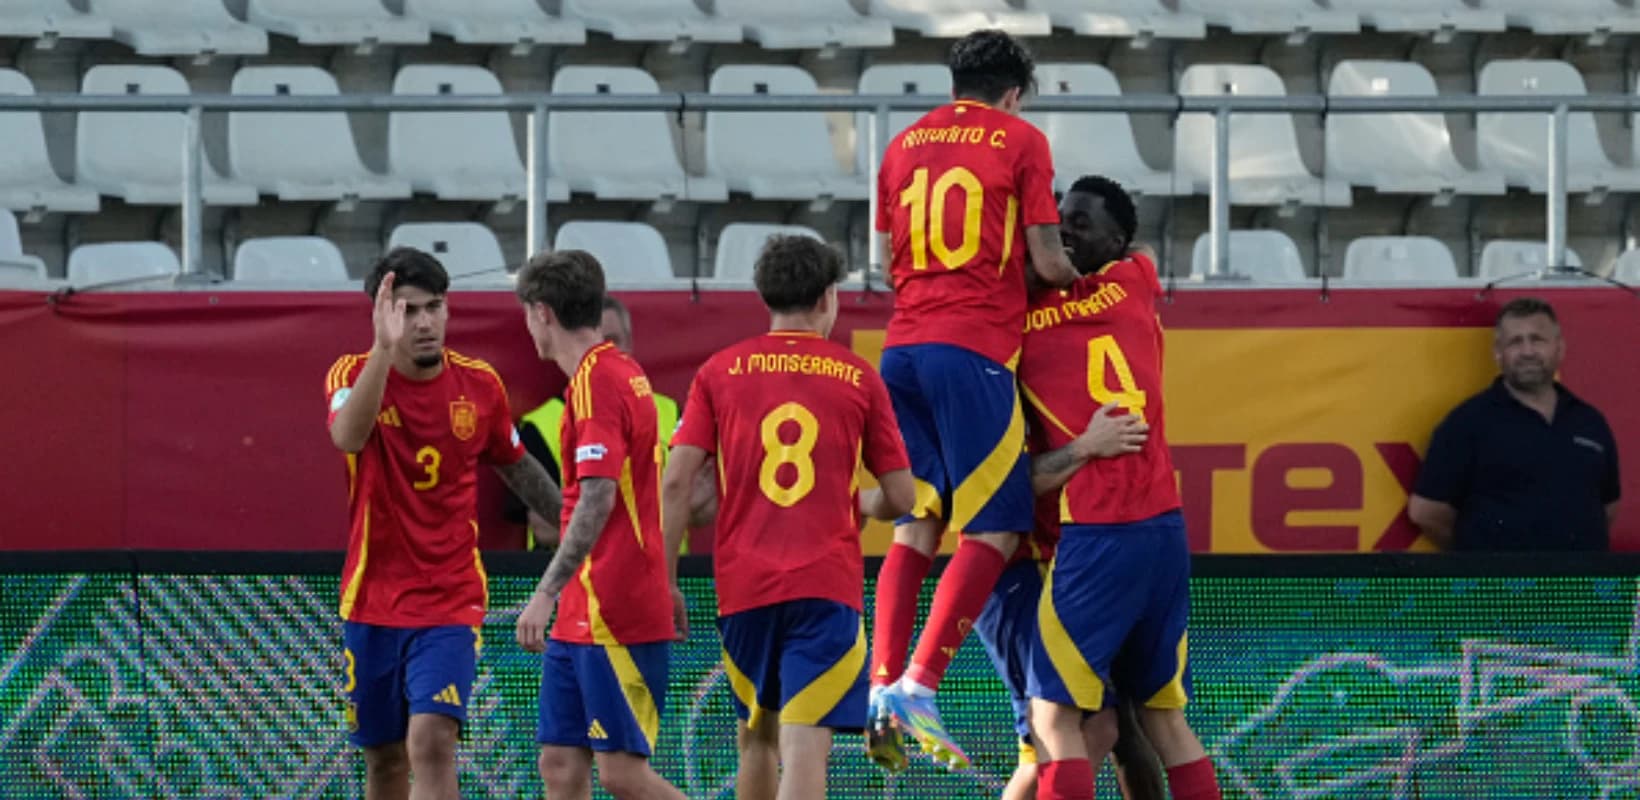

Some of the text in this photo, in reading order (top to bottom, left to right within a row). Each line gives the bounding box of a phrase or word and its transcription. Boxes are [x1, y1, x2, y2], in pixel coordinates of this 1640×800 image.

[989, 129, 1006, 149] C.
[901, 166, 984, 270] 10
[1022, 307, 1061, 333] JON
[728, 353, 864, 388] J. MONSERRATE
[1087, 334, 1147, 424] 4
[413, 445, 441, 490] 3
[759, 402, 819, 507] 8
